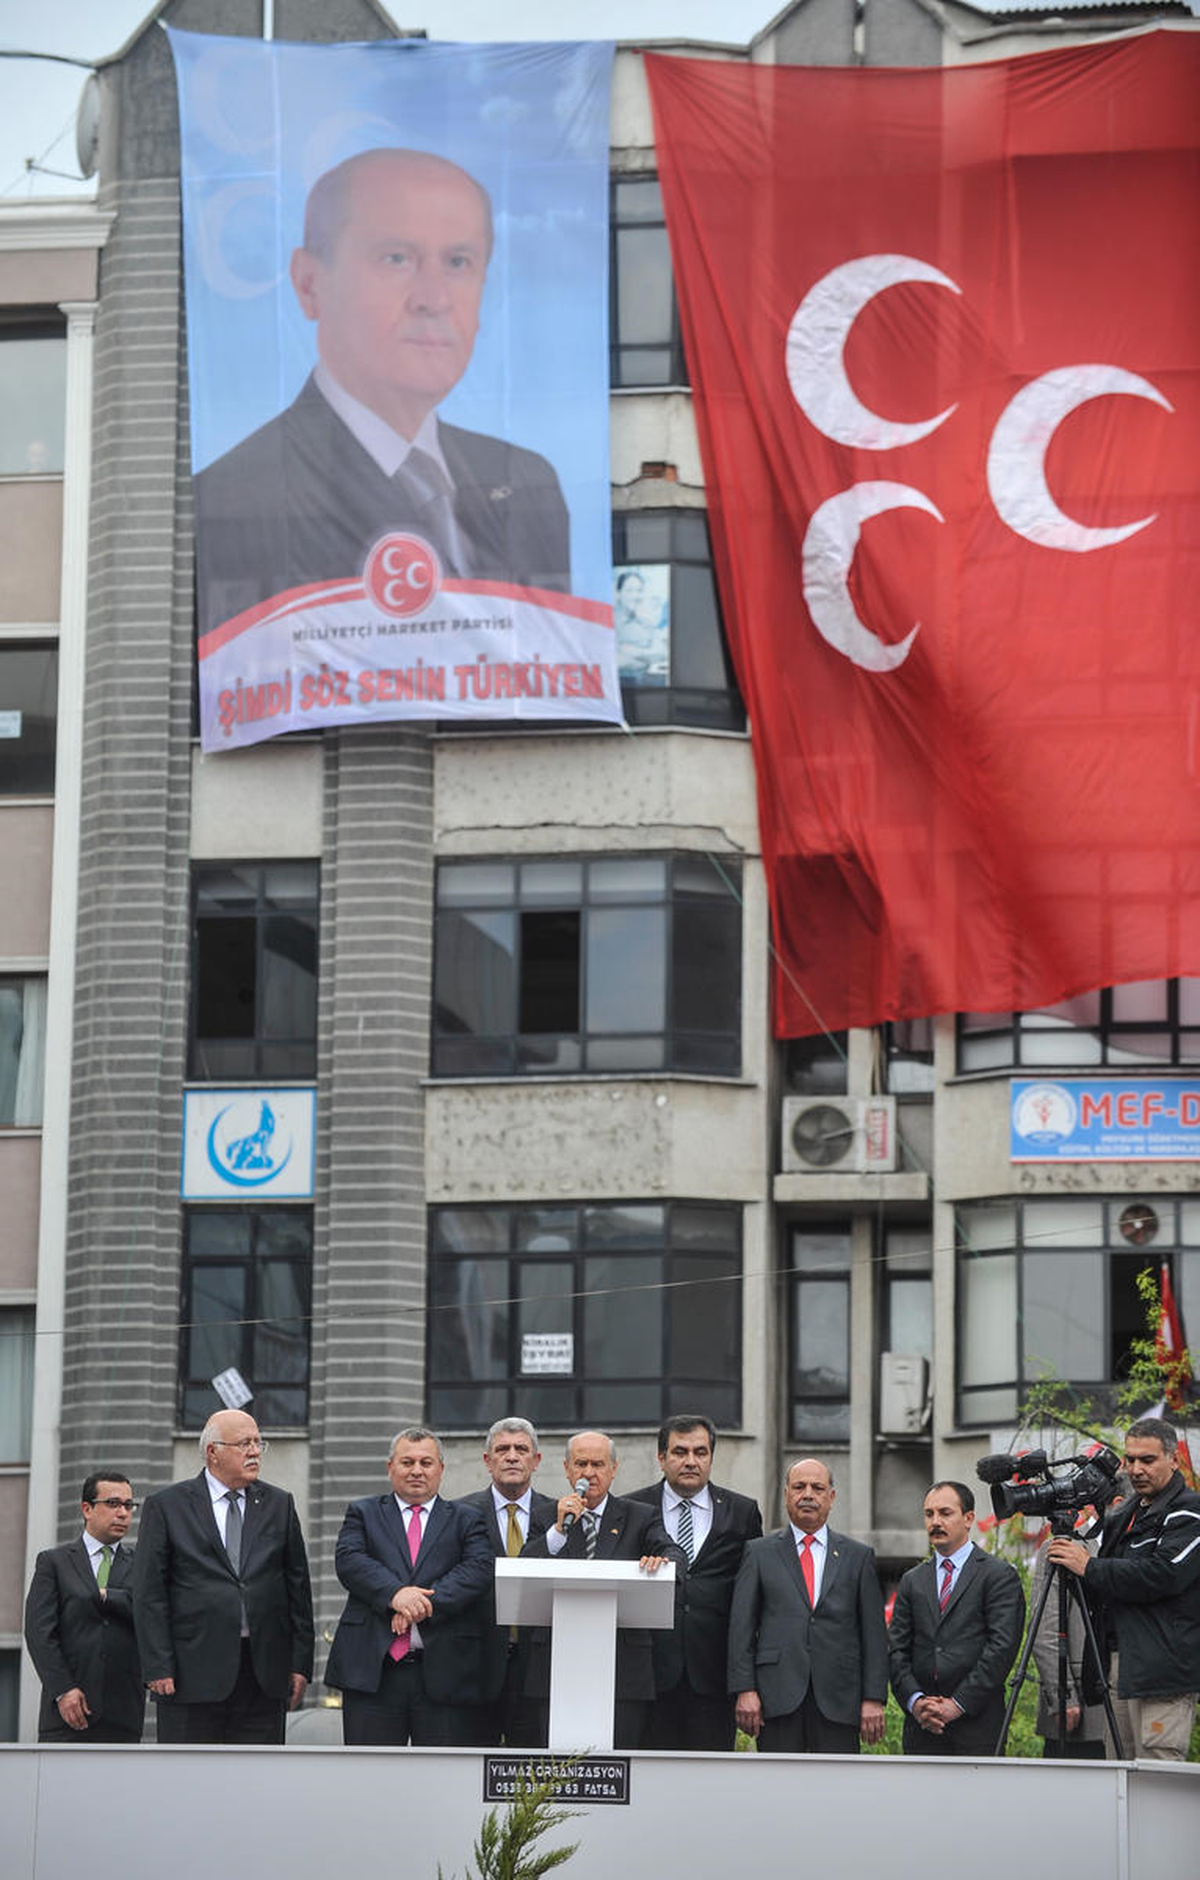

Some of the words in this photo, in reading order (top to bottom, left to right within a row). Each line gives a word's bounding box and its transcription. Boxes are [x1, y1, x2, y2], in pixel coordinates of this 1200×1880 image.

[293, 622, 372, 641] MİLLİYETÇİ
[377, 619, 447, 636] HAREKET
[452, 614, 514, 631] PARTİSİ
[218, 668, 292, 737] ŞİMDİ
[300, 663, 351, 711] SÖZ
[357, 657, 446, 705] SENİN
[491, 1765, 532, 1777] YILMAZ
[536, 1764, 623, 1779] ORGANİZASYON
[565, 1783, 579, 1795] 63
[584, 1783, 617, 1796] FATSA
